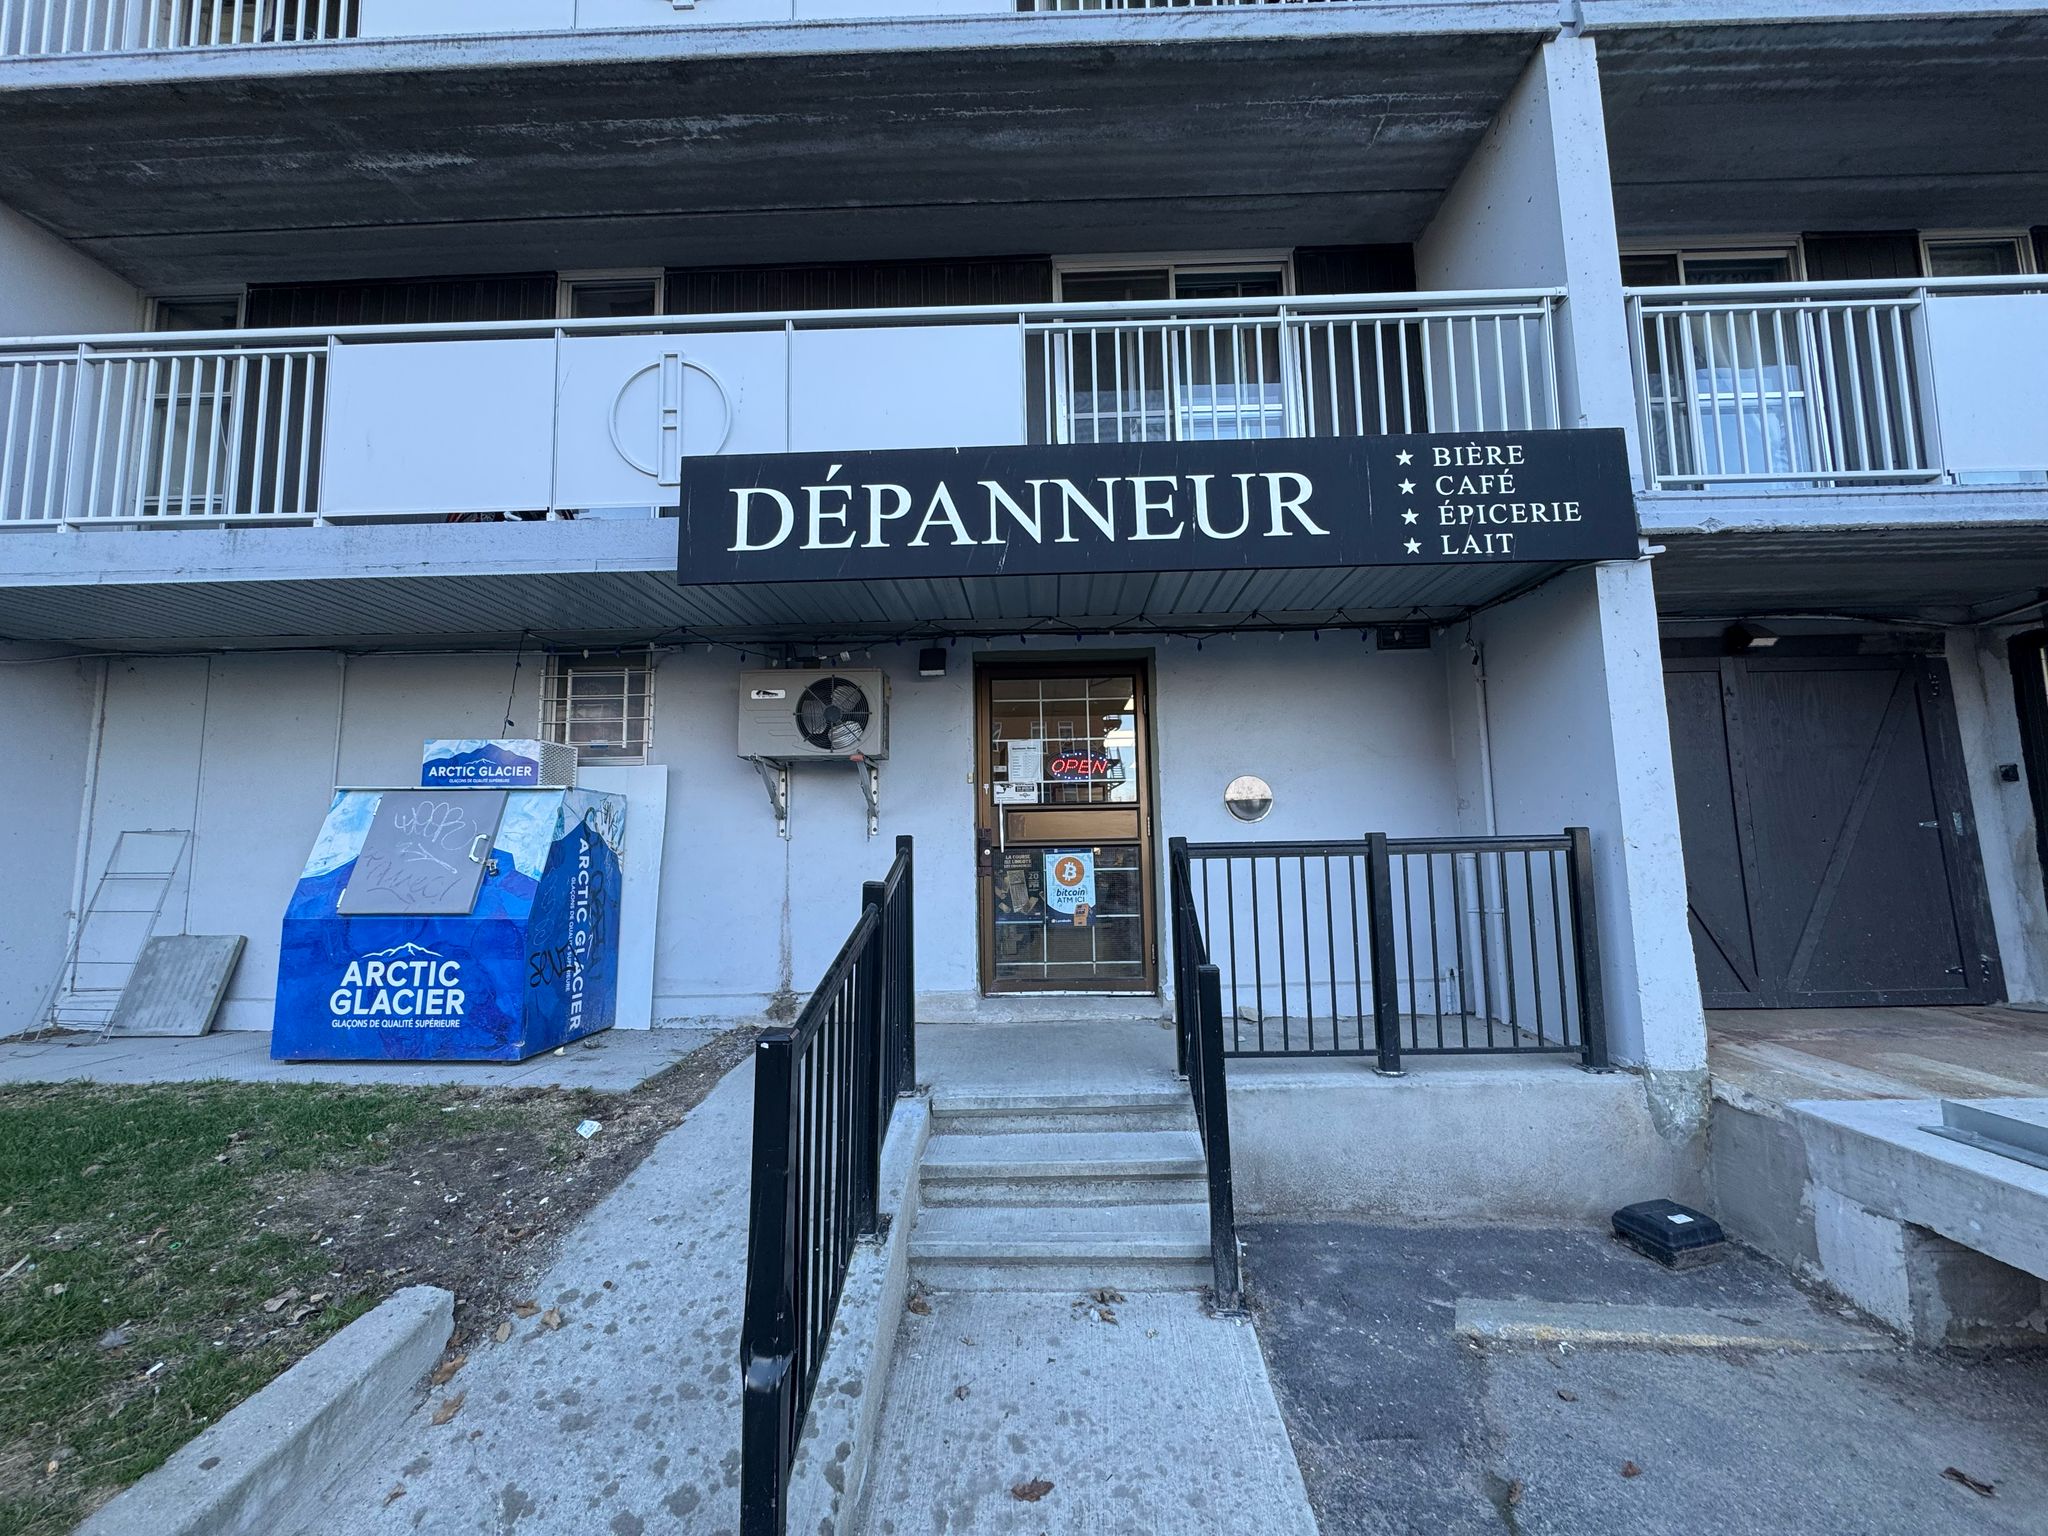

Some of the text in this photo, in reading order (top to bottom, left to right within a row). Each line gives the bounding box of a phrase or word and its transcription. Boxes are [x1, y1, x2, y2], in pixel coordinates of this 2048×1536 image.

[1432, 442, 1526, 467] BIÈRE
[1435, 468, 1516, 496] CAFÉ
[727, 464, 1330, 553] DÉPANNEUR
[1438, 500, 1582, 526] ÉPICERIE
[1441, 533, 1514, 555] LAIT
[428, 766, 532, 777] ARCTIC GLACIER
[1051, 759, 1108, 774] OPEN
[577, 838, 590, 923] ARCTIC
[1056, 887, 1086, 897] bitcoin
[1057, 896, 1074, 904] ATM
[340, 960, 461, 987] ARCTIC
[329, 988, 465, 1015] GLACIER
[331, 1017, 460, 1031] GLAÇONS DE QUALITÉ SUPÉRIEURE
